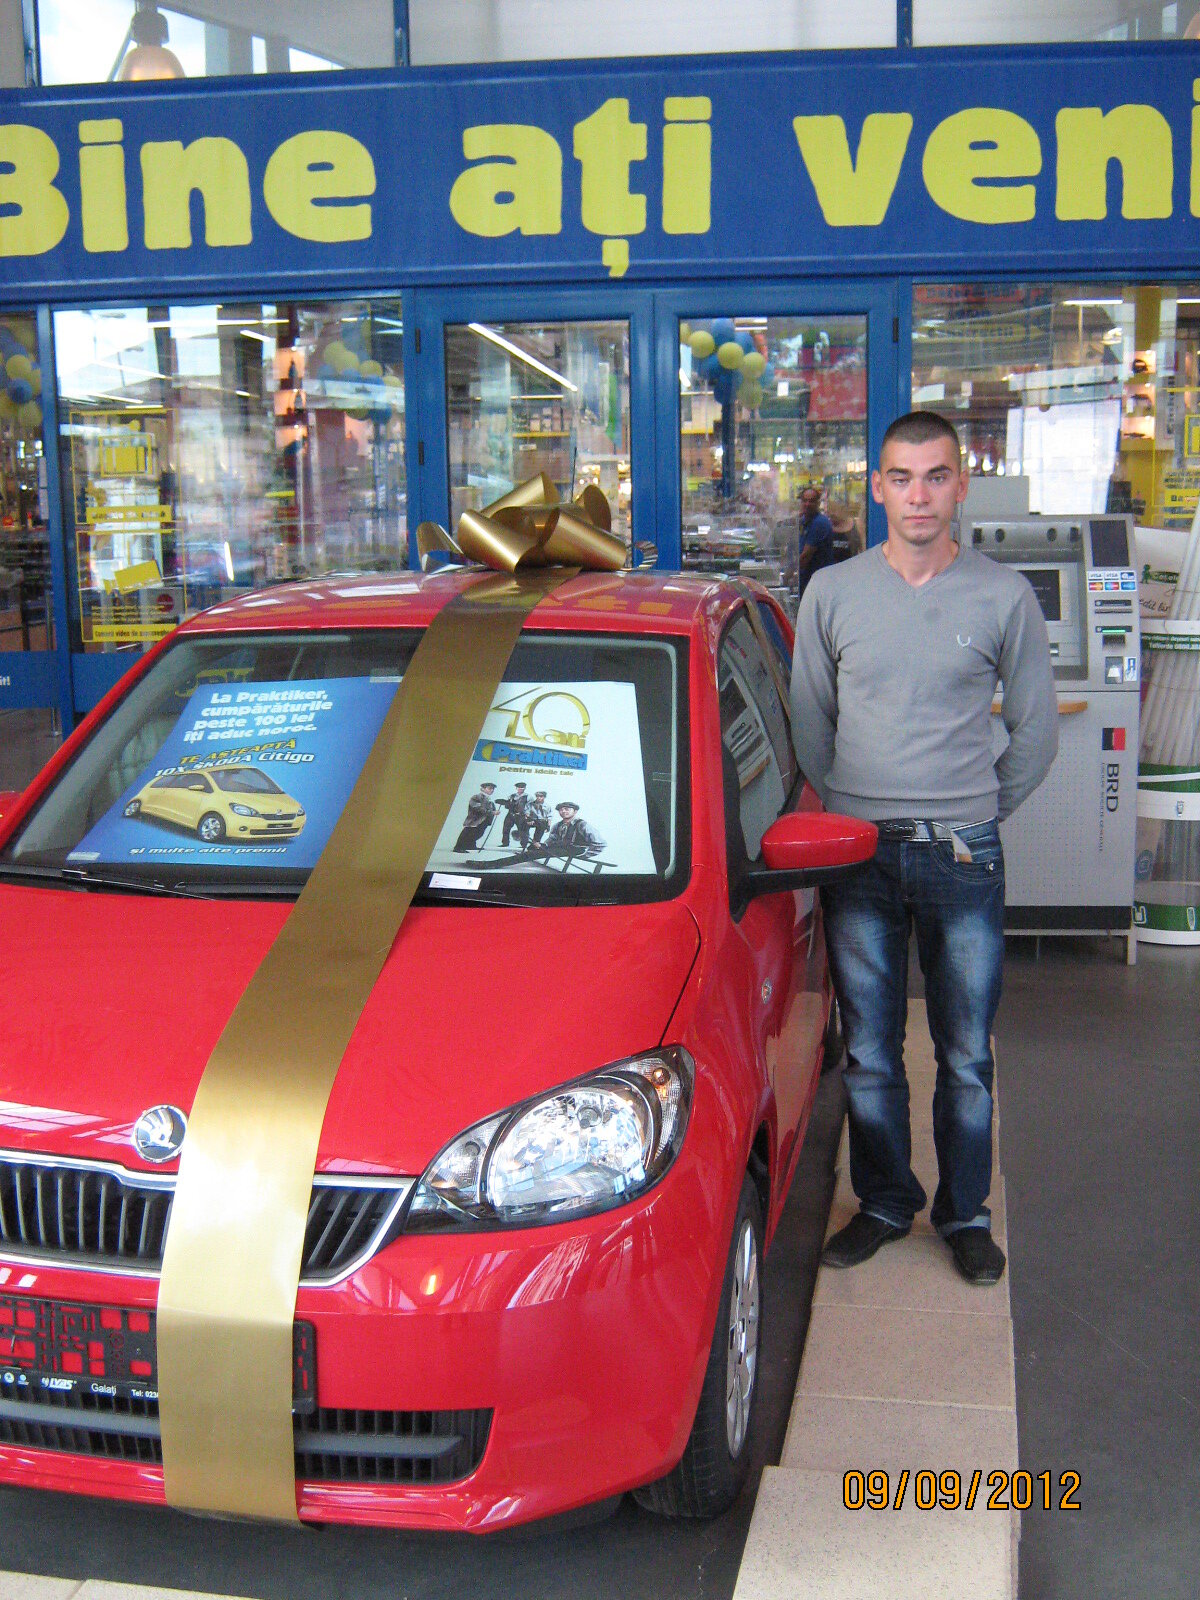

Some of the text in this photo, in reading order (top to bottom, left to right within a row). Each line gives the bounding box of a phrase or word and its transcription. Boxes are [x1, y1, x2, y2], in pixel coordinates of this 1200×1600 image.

[0, 118, 377, 257] Bine
[793, 79, 1200, 227] ven
[210, 688, 328, 704] La Praktiker,
[201, 700, 333, 717] cumpărăturile
[193, 711, 316, 731] peste 100 lei
[207, 727, 255, 741] aduc
[257, 723, 318, 737] noroc.
[180, 754, 204, 765] TE
[258, 752, 315, 764] Citigo
[491, 741, 586, 770] Praktiker
[499, 765, 533, 774] pentru
[560, 769, 574, 777] tale
[1106, 763, 1120, 813] BRD
[148, 846, 196, 855] multe
[198, 846, 232, 855] alte
[234, 846, 288, 856] premii
